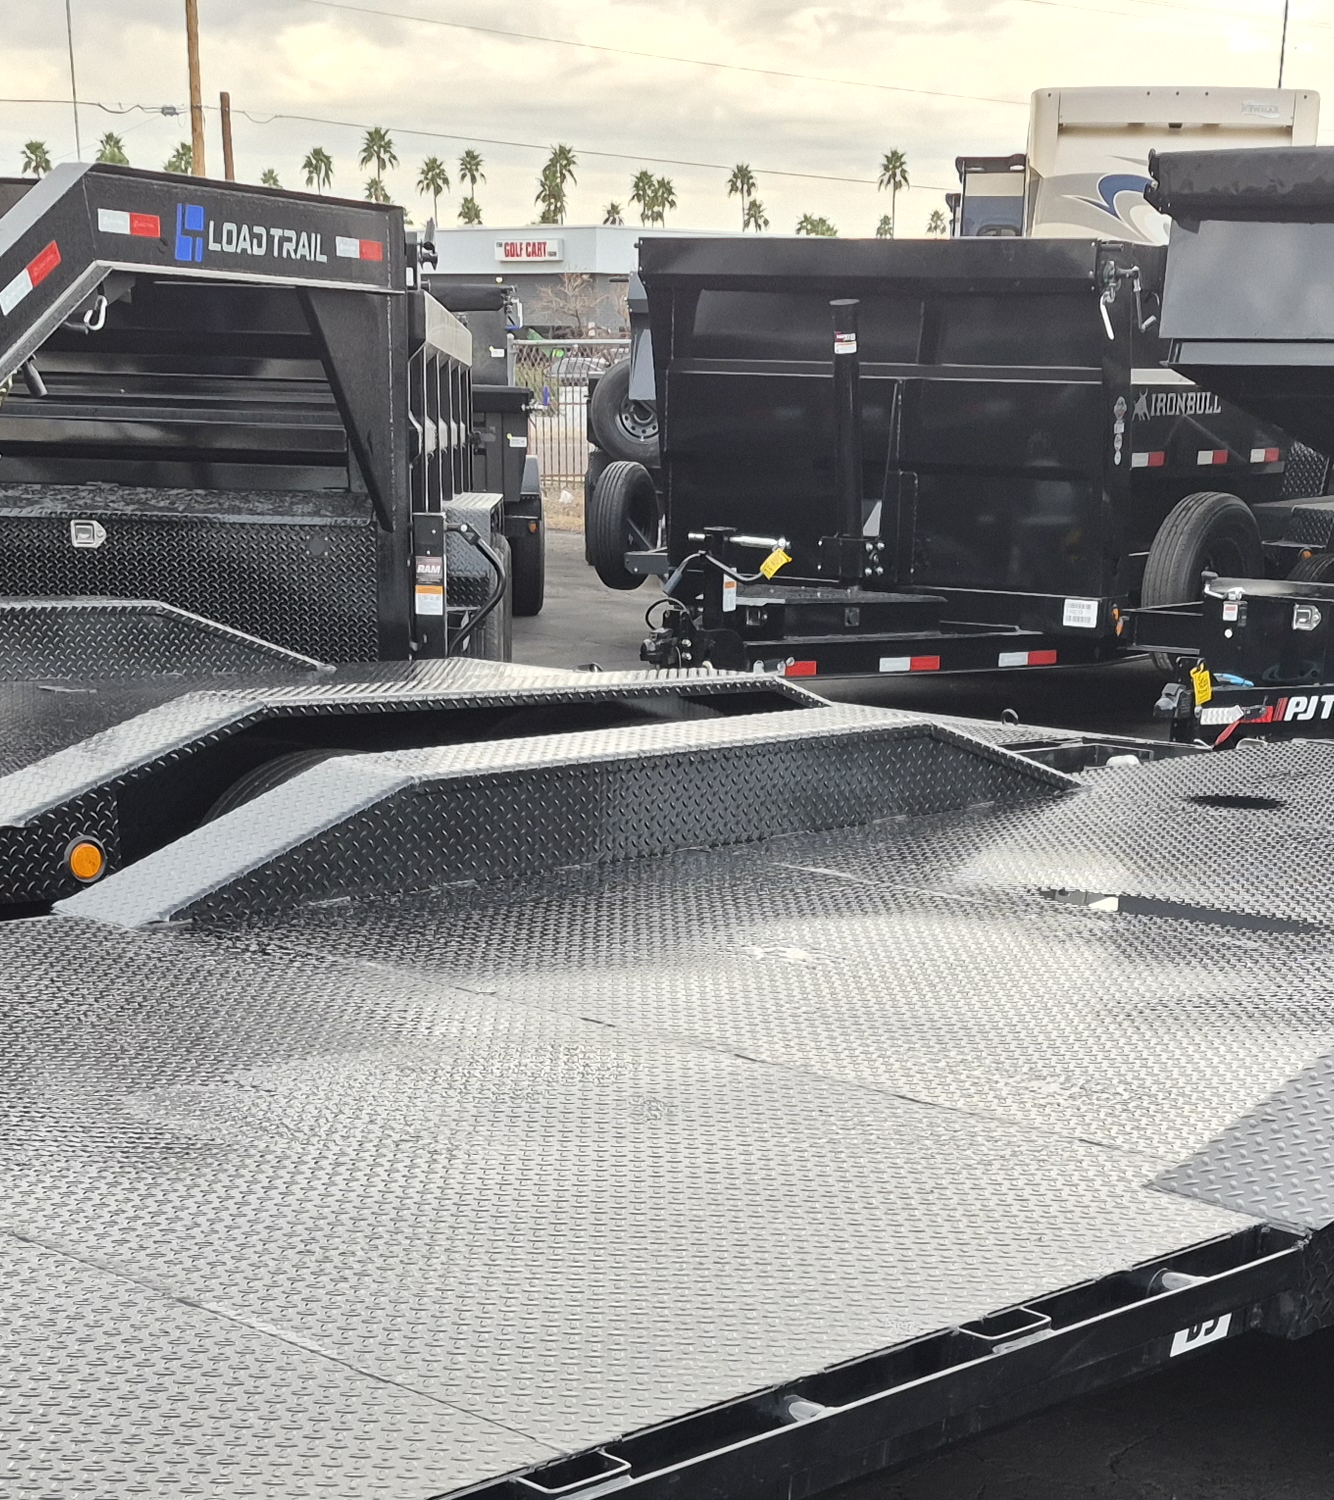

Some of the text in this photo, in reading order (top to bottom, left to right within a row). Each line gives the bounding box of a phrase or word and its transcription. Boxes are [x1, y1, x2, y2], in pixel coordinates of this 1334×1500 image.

[208, 220, 328, 264] LOAD TRAIL
[504, 242, 547, 257] GOLF CART
[1150, 391, 1222, 416] IRONBULL
[416, 564, 441, 574] RAM
[1283, 696, 1319, 721] PJ
